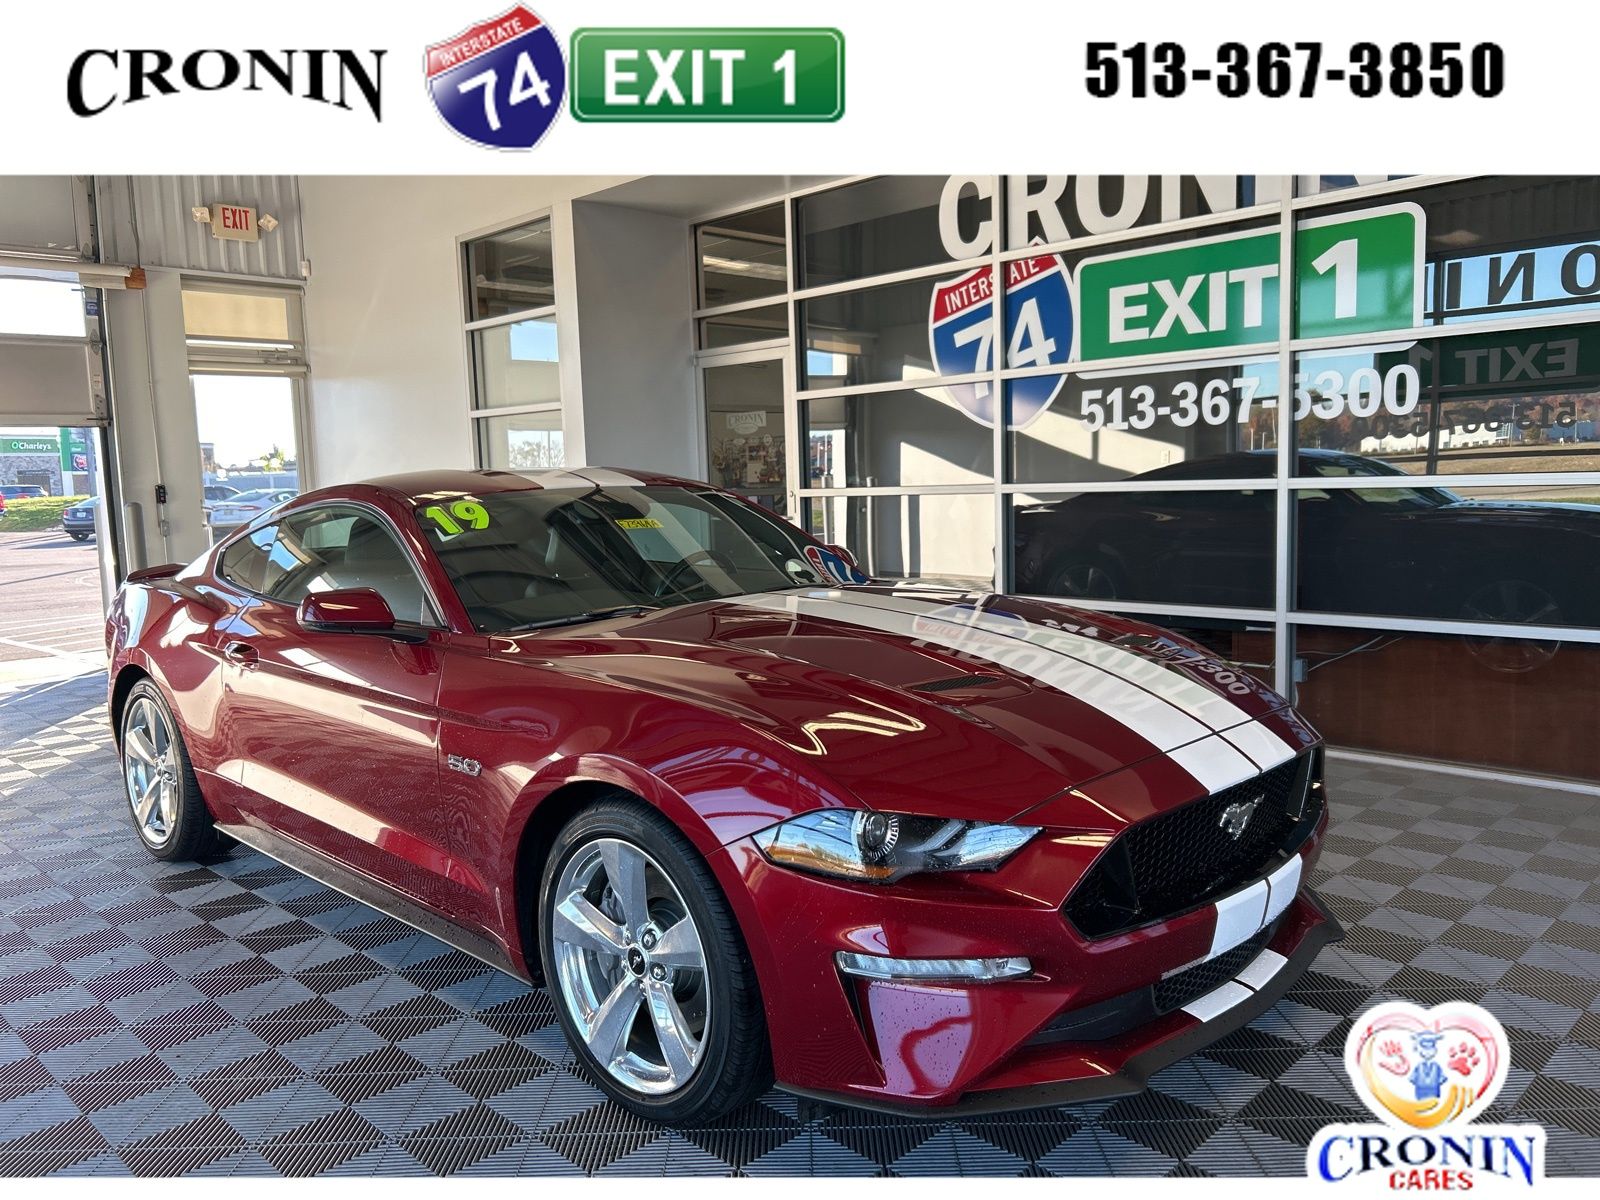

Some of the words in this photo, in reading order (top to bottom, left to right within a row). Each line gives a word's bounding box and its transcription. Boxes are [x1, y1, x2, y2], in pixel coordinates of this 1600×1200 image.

[223, 207, 249, 230] EXIT
[944, 255, 1040, 313] INTERSATE
[1108, 264, 1280, 344] EXIT
[1311, 237, 1359, 318] 1
[953, 297, 1056, 399] 74
[1079, 364, 1419, 432] 513-367-5300
[427, 500, 490, 534] 19
